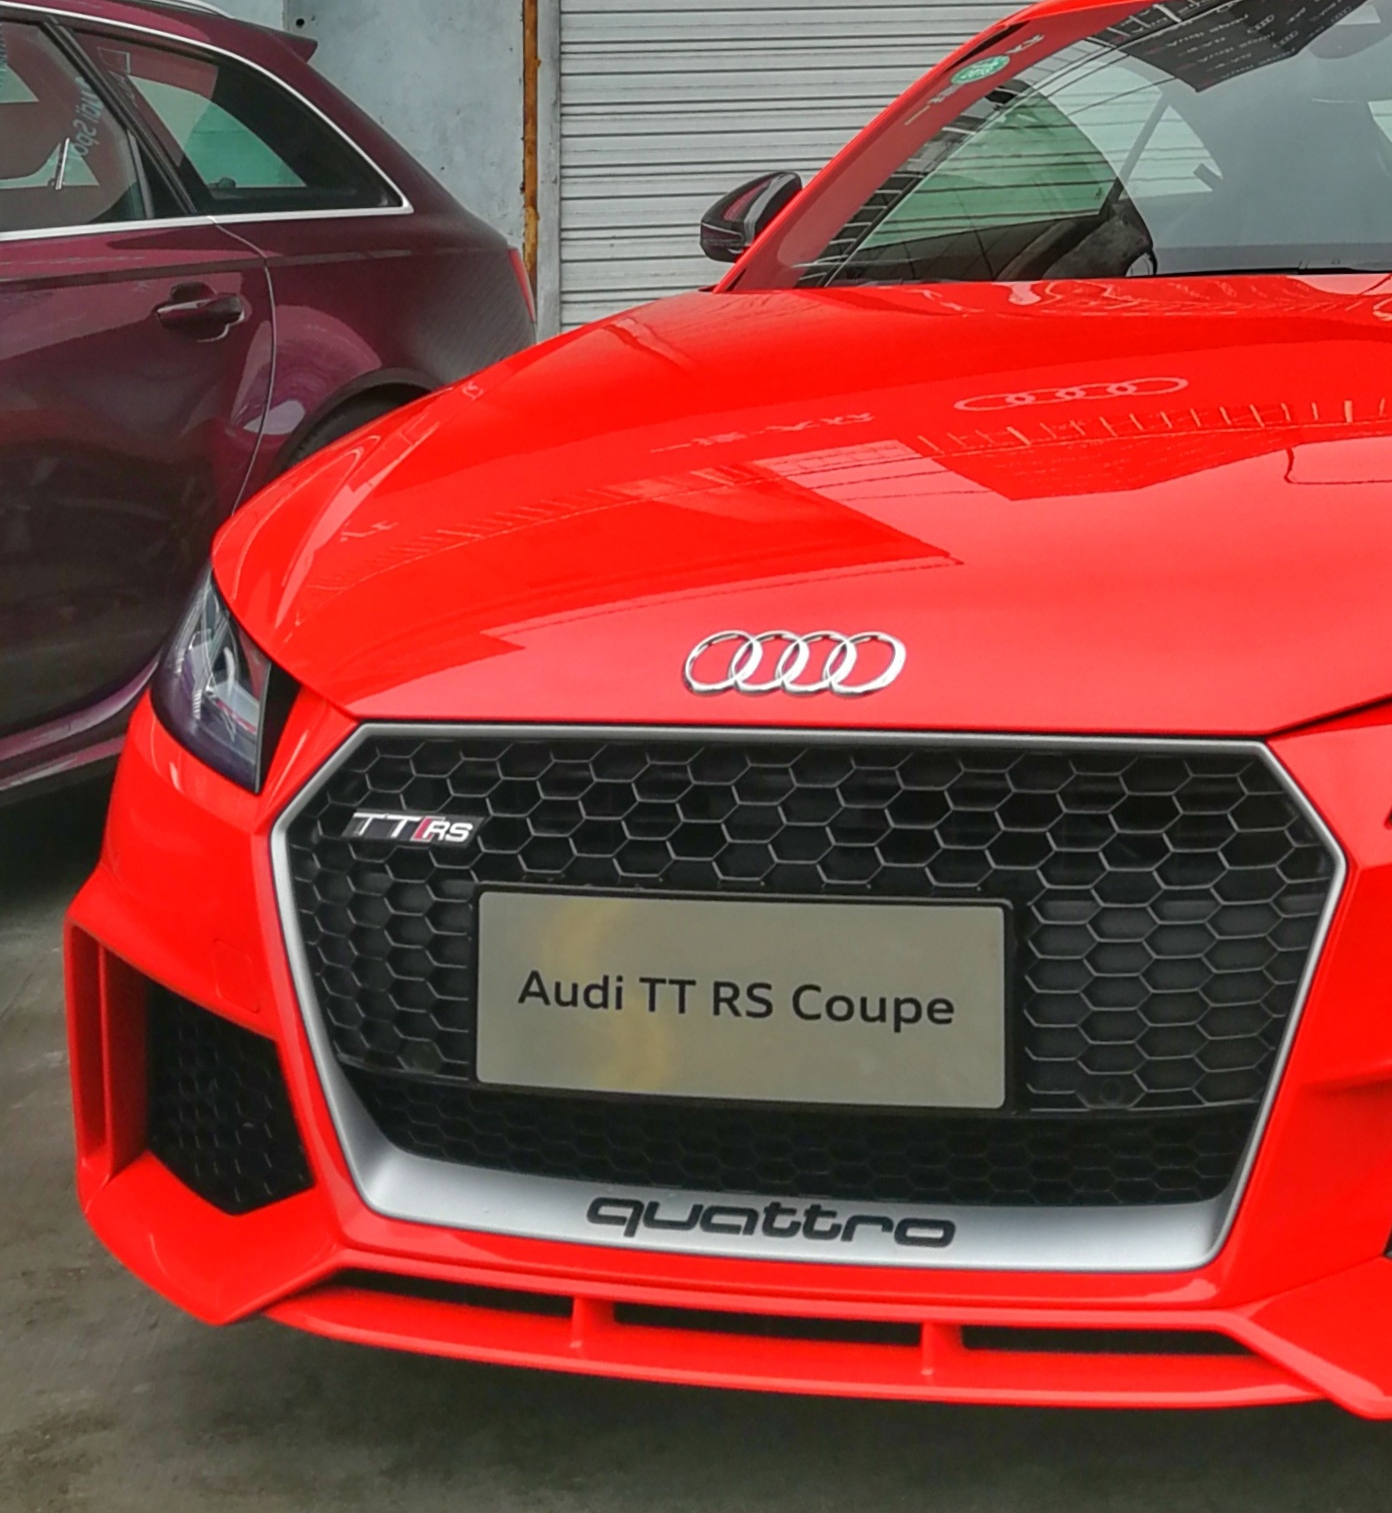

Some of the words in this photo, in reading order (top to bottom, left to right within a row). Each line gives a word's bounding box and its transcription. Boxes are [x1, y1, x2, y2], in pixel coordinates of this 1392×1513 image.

[517, 970, 625, 1012] Audi
[638, 977, 697, 1014] TT
[711, 981, 774, 1019] RS
[791, 984, 956, 1033] Coupe
[586, 1197, 956, 1248] quattro
